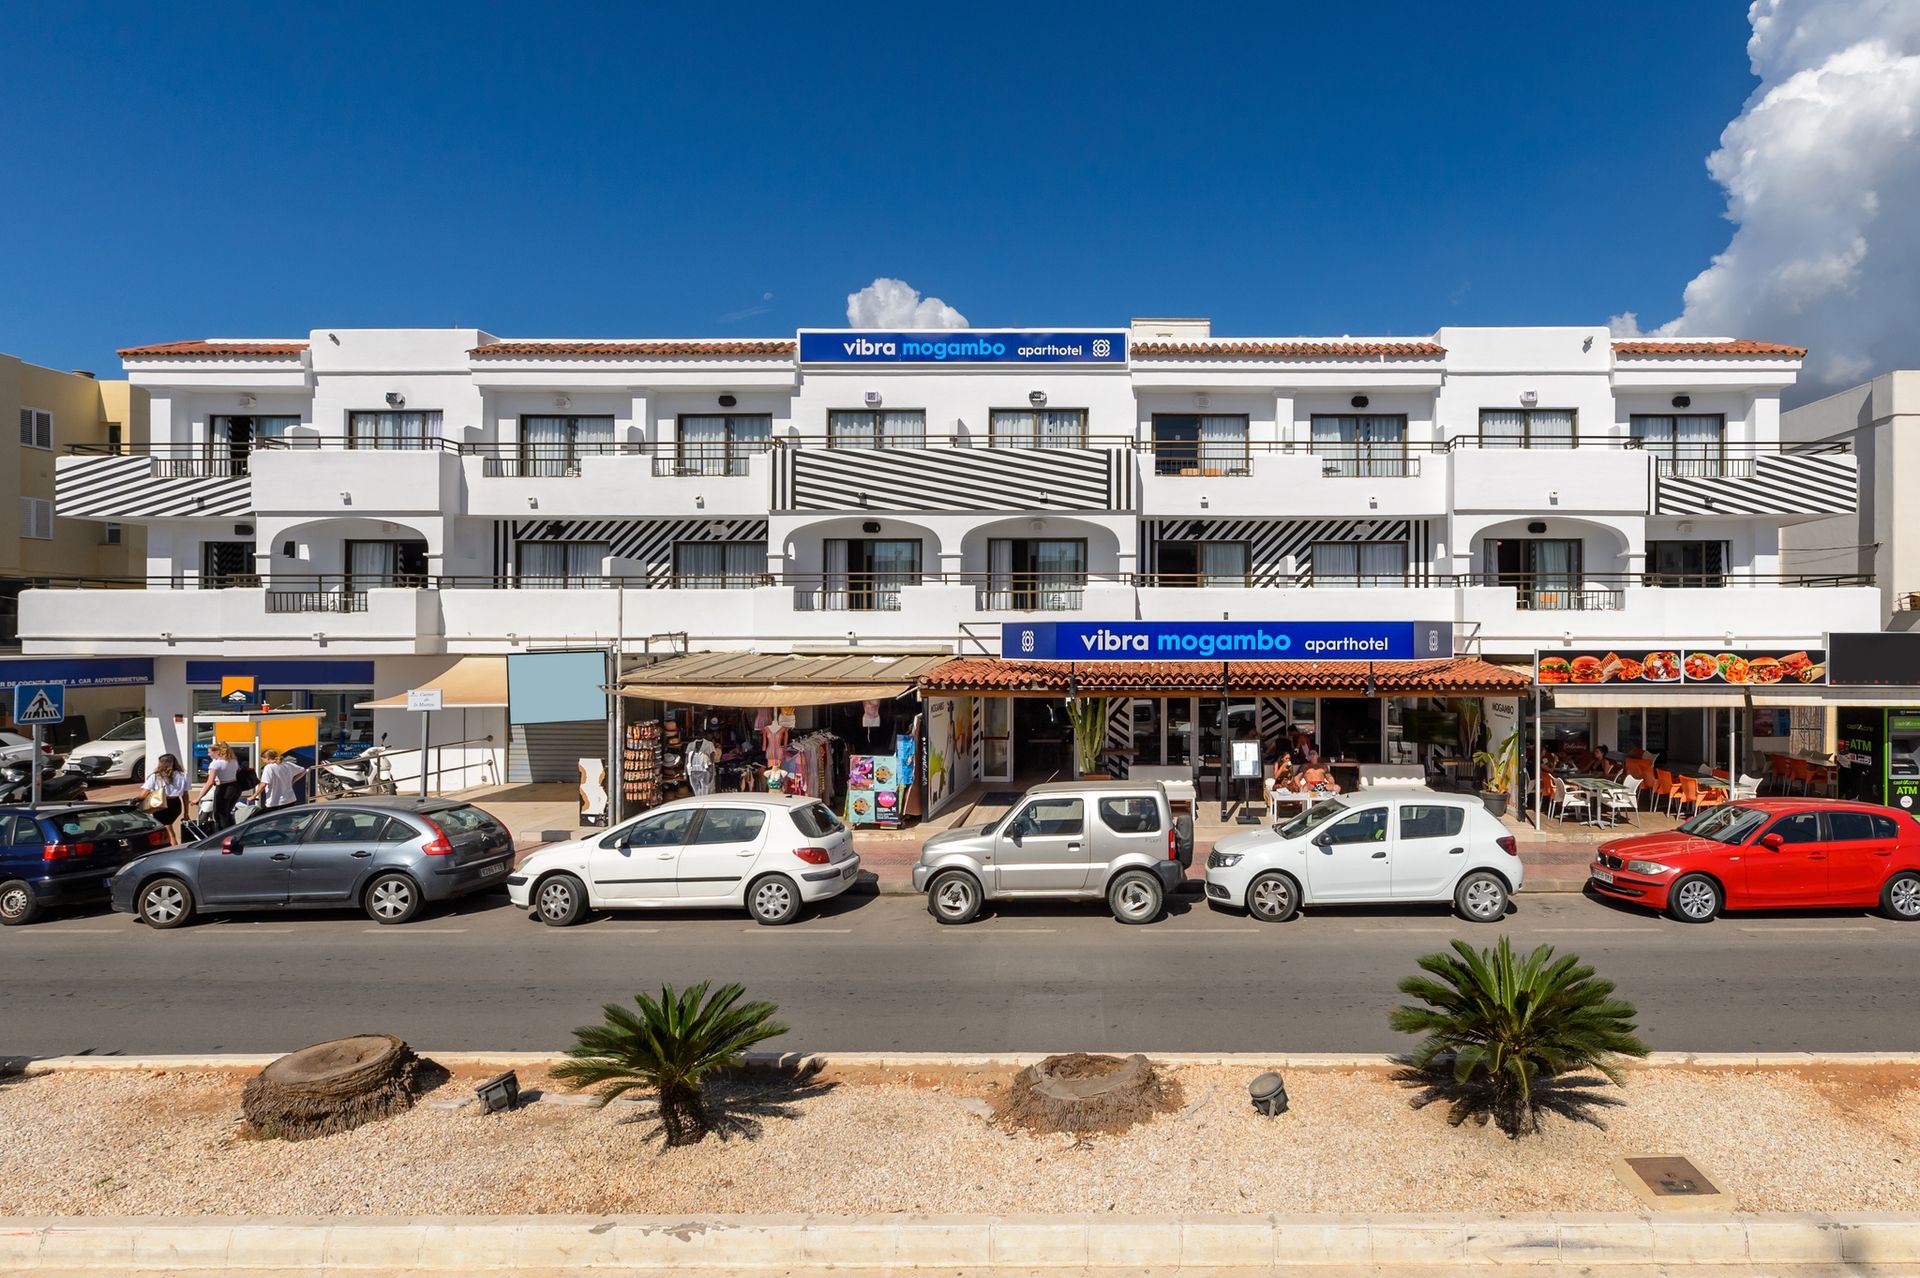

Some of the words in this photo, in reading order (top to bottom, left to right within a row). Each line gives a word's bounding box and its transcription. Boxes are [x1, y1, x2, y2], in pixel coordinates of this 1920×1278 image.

[843, 338, 896, 356] vibra
[902, 338, 1006, 360] mogambo
[1017, 344, 1083, 358] aparthotel
[1080, 629, 1149, 651] vibra
[1158, 629, 1291, 657] mogambo
[1304, 637, 1389, 655] aparthotel
[1492, 702, 1514, 715] MOGAMBO
[1850, 738, 1872, 752] ATM
[1896, 786, 1918, 795] ATM
